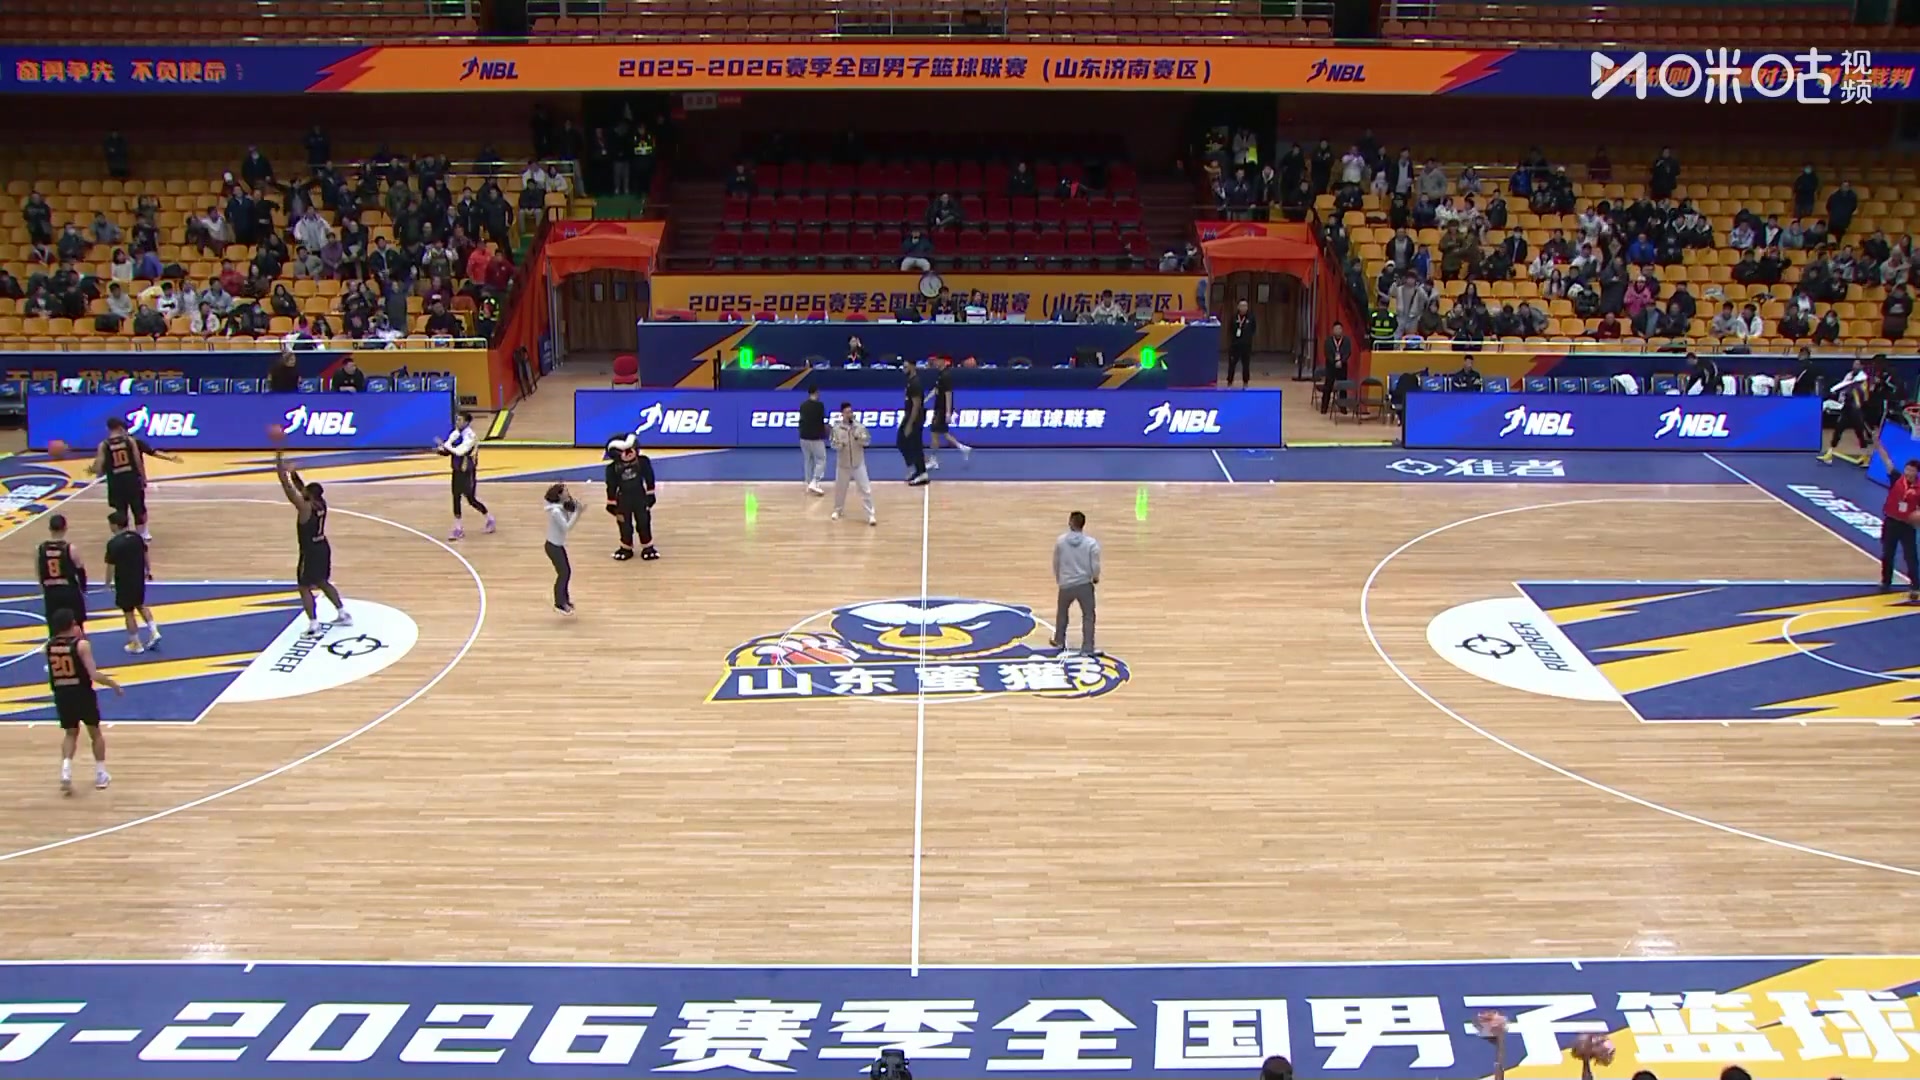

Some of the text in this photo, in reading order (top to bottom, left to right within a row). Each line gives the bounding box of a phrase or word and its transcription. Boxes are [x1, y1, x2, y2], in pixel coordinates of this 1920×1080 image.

[131, 60, 228, 82] 不负使命
[480, 61, 519, 80] NBL
[1326, 62, 1366, 82] NBL
[150, 412, 200, 437] NBL
[306, 411, 357, 436] NBL
[660, 409, 713, 434] NBL
[1169, 408, 1221, 433] NBL
[1525, 411, 1574, 437] NBL
[1679, 412, 1730, 438] NBL
[112, 450, 129, 467] 10
[1508, 621, 1577, 672] RIGORER
[50, 655, 76, 677] 20
